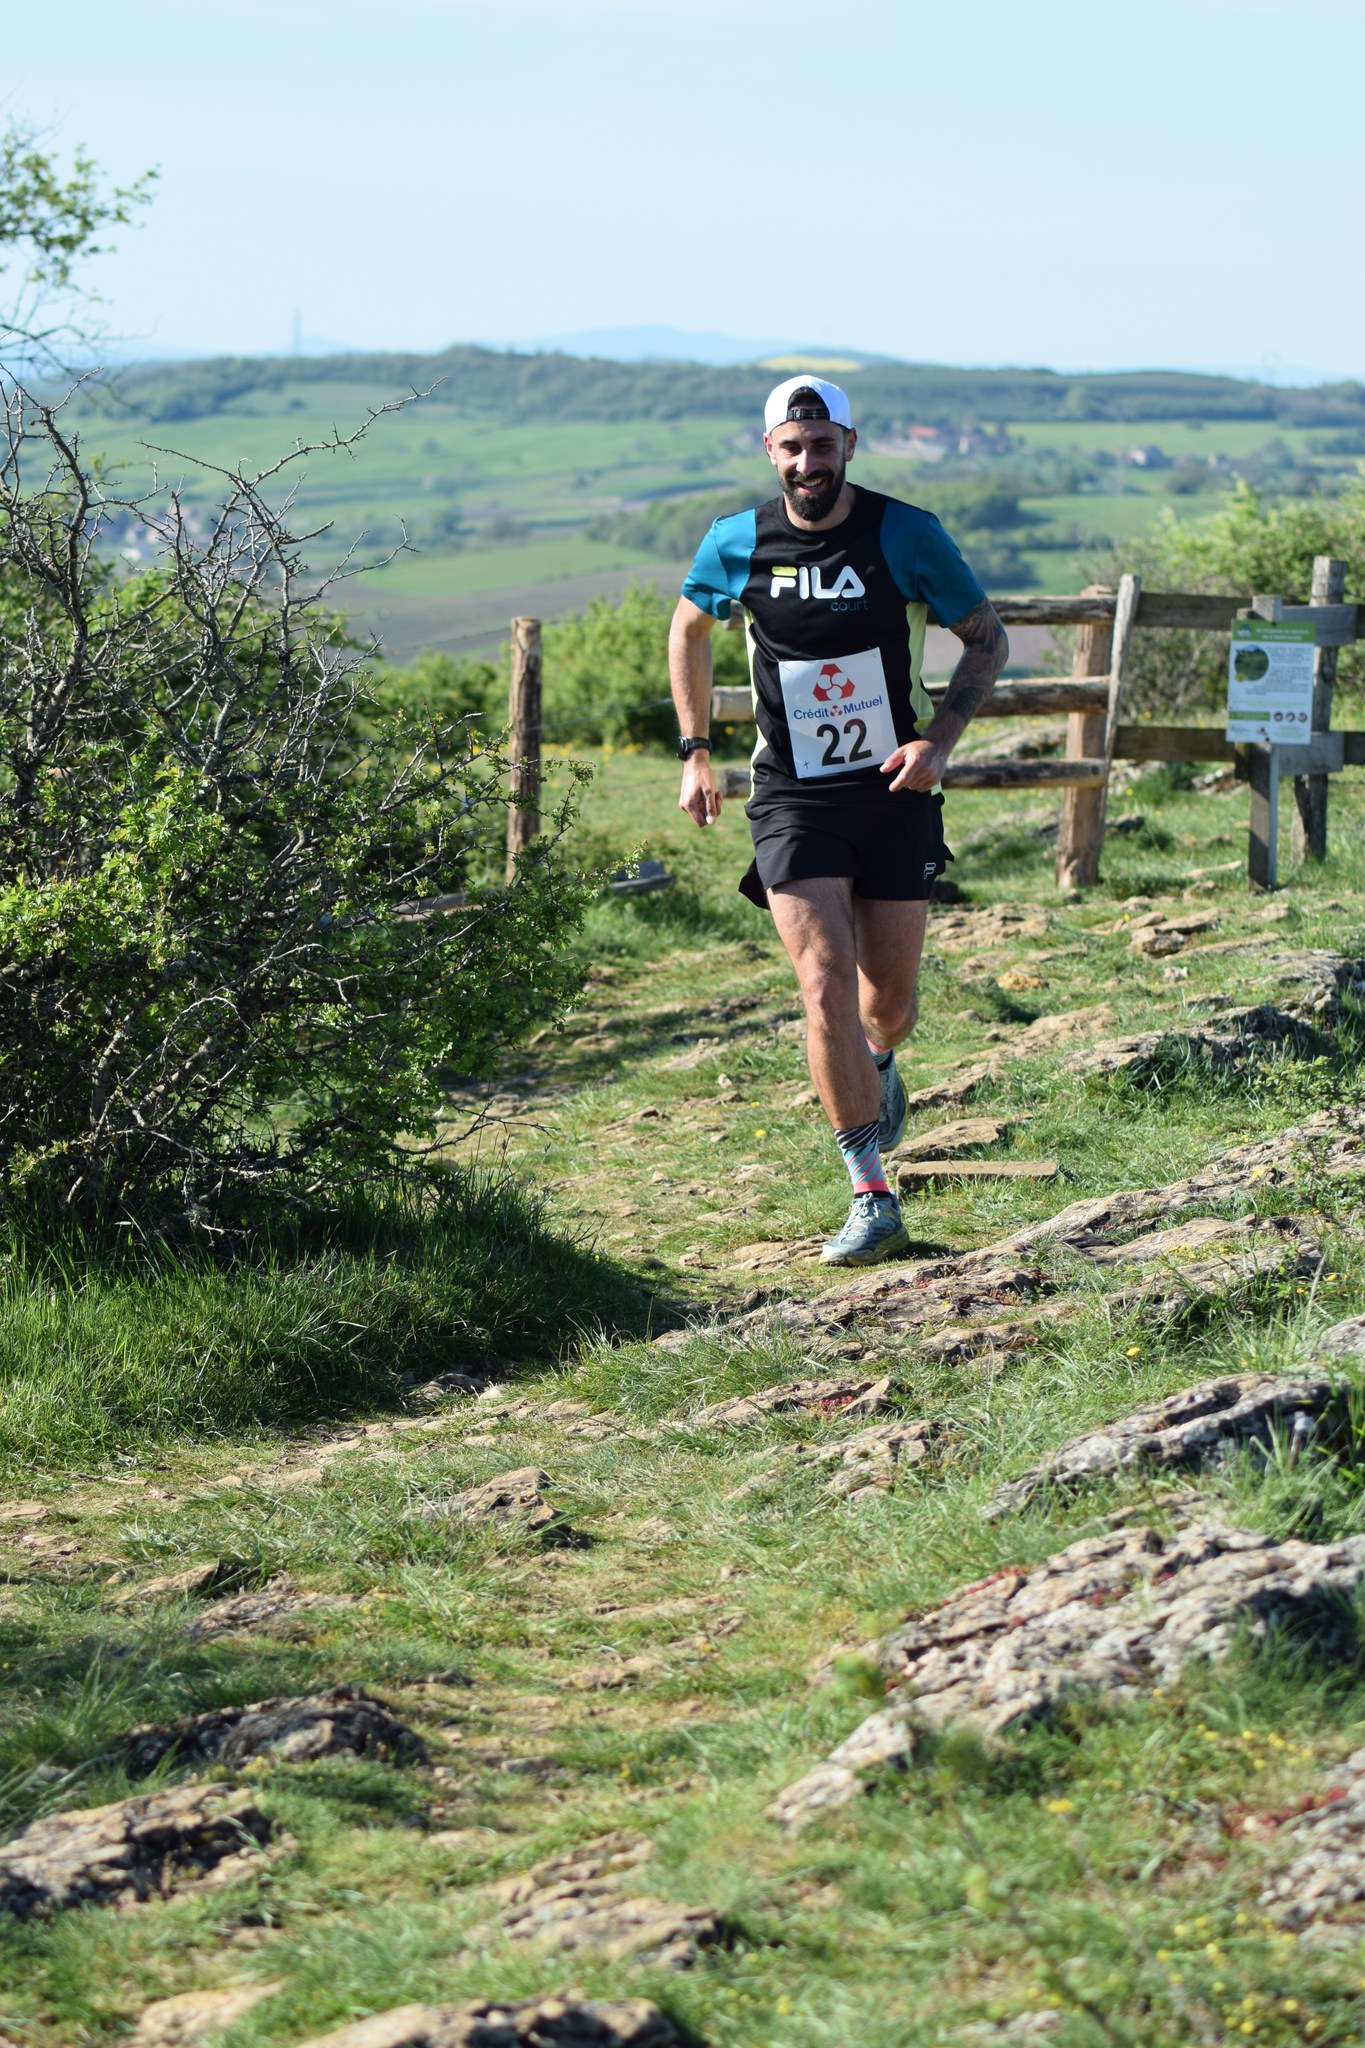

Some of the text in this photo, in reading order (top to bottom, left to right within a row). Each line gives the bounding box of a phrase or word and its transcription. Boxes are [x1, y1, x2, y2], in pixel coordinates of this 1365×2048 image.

[770, 565, 866, 600] FILA
[830, 598, 869, 612] court
[793, 695, 883, 720] Crédit Mutuel
[816, 718, 873, 767] 22
